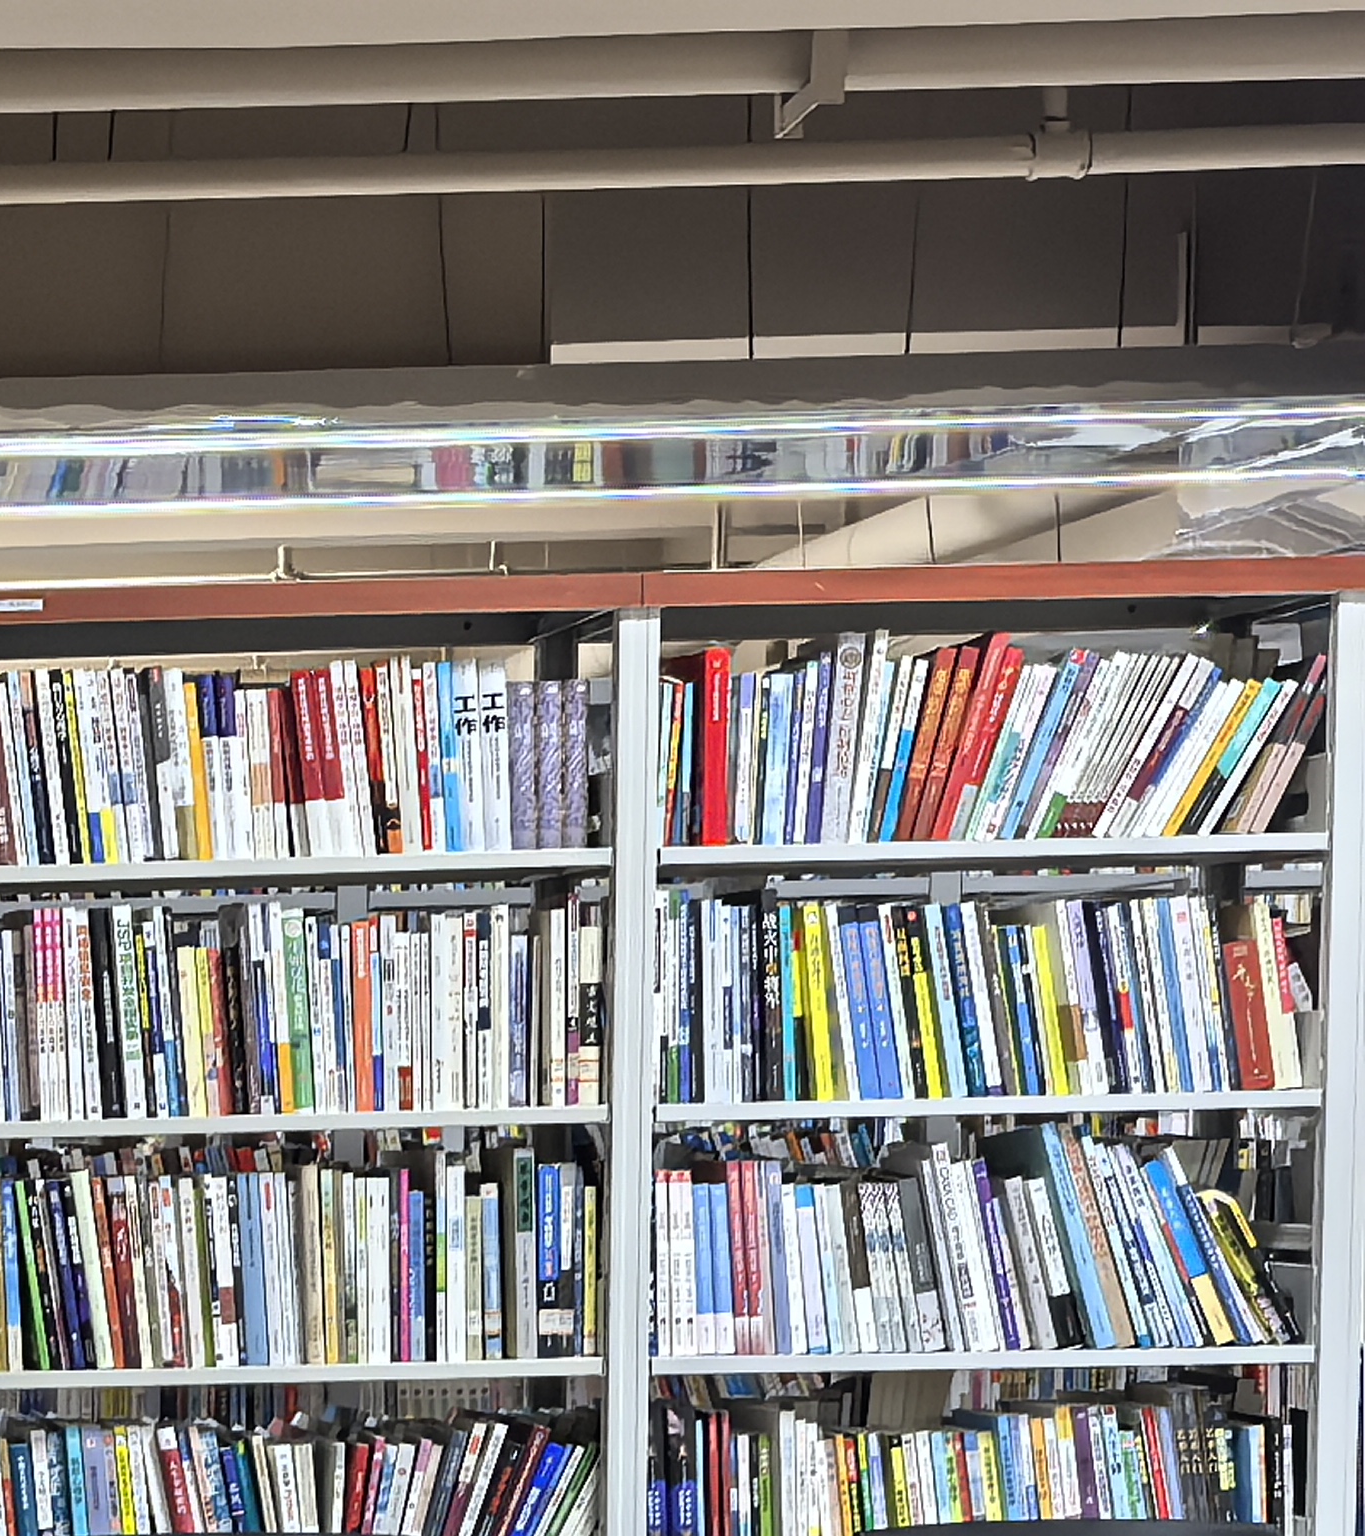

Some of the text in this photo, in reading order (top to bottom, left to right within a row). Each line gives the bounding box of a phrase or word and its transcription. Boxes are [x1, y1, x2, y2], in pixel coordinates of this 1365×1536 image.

[454, 695, 478, 736] 工作
[482, 692, 506, 733] 工作
[116, 919, 132, 951] JSP
